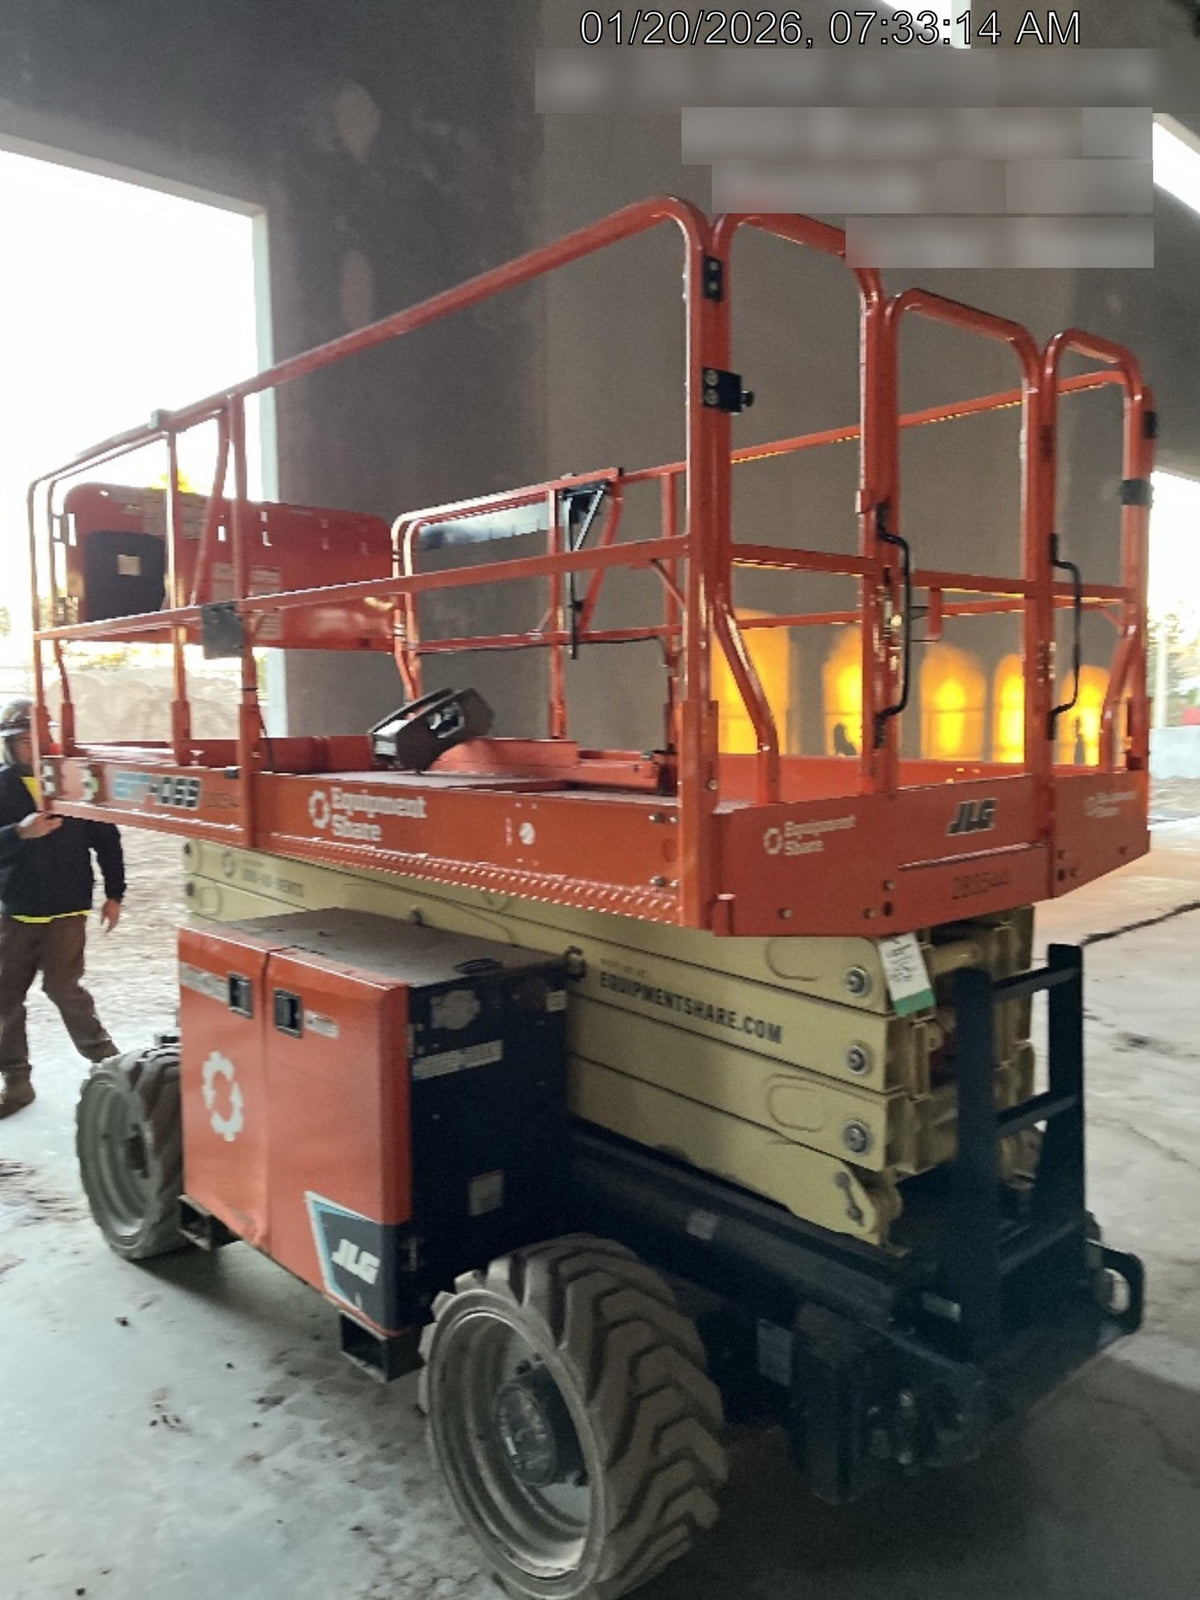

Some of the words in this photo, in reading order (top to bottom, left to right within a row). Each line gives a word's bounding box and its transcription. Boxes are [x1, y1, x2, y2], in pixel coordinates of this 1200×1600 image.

[330, 786, 427, 818] Equipment
[947, 798, 998, 836] JLG
[332, 814, 382, 841] Share
[600, 971, 783, 1044] EQUIPMENTSHARE.COM
[331, 1238, 381, 1286] JLG
